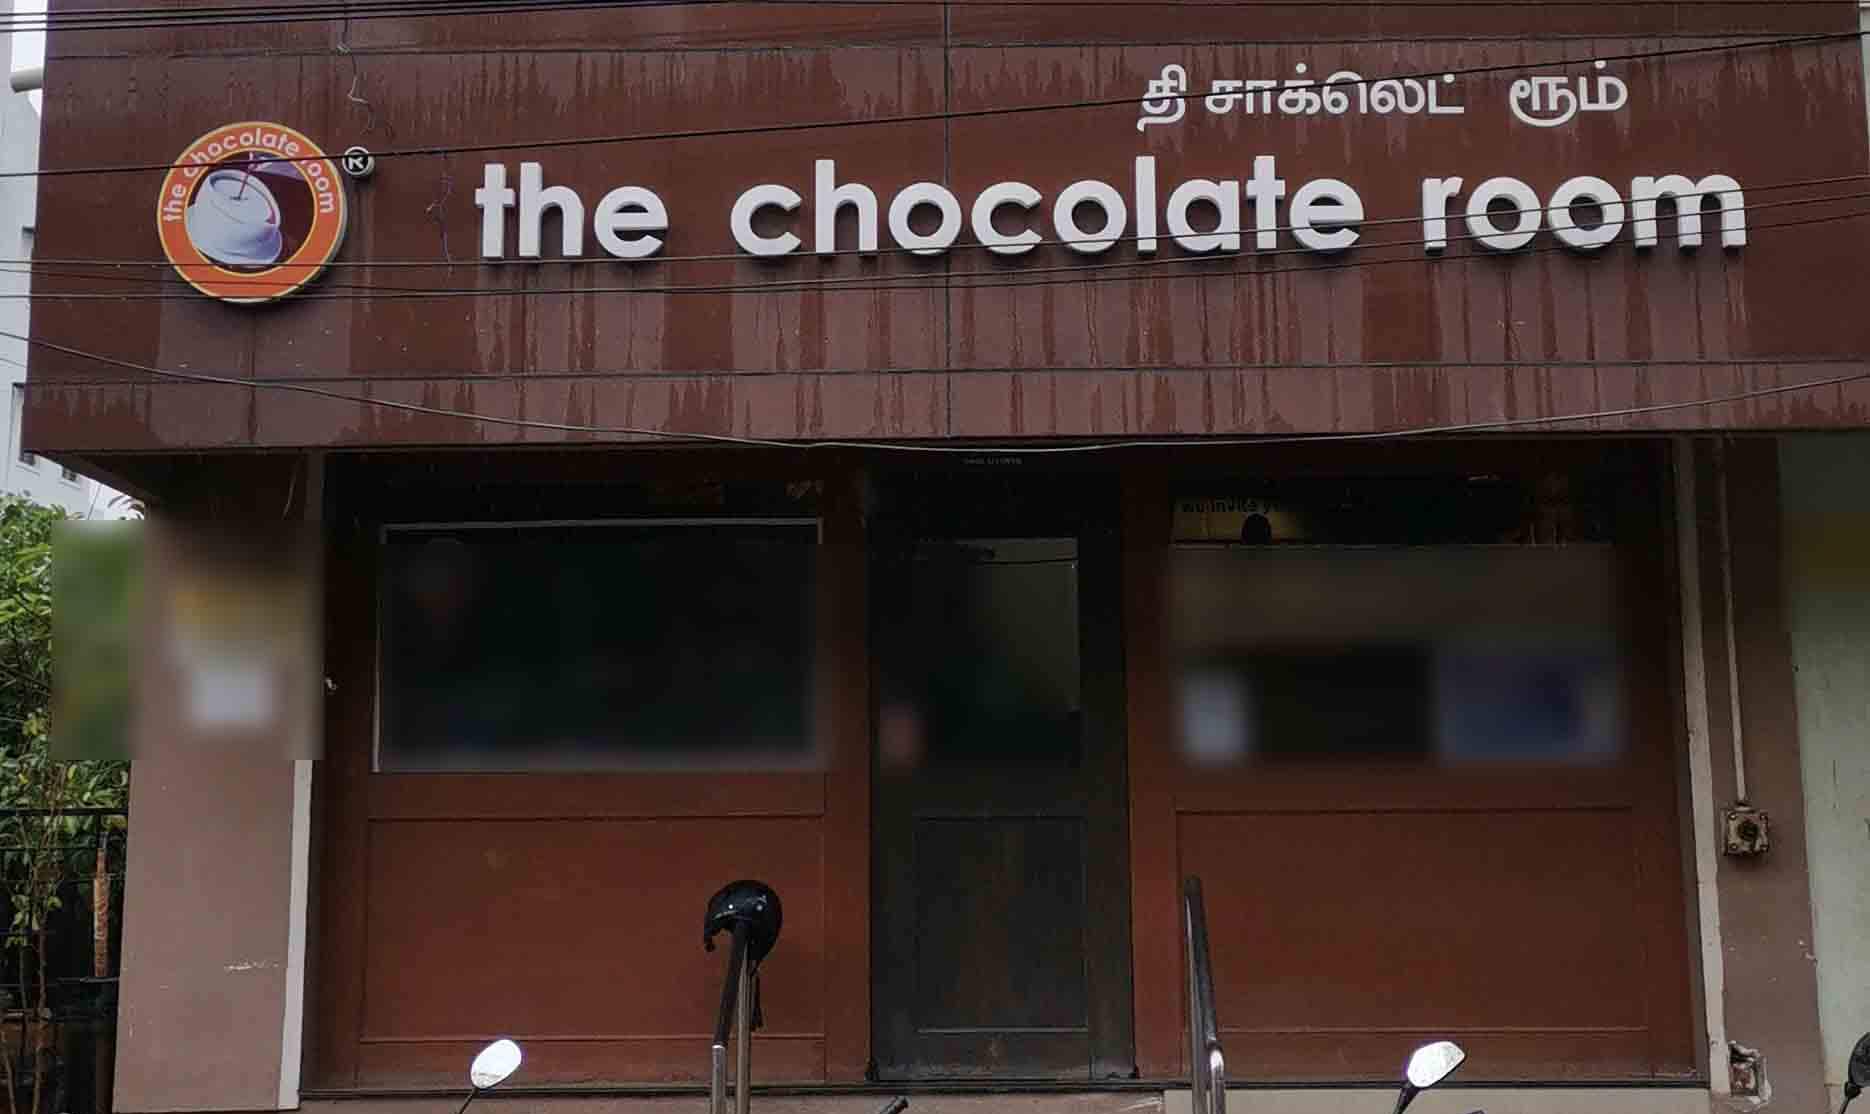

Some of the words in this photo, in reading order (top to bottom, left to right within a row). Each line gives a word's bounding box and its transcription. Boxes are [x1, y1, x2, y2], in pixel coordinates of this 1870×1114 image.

[1136, 63, 1187, 131] தி
[1510, 60, 1628, 127] ரூம்
[164, 184, 187, 222] the
[183, 128, 300, 178] chocolate
[475, 161, 669, 258] the
[730, 155, 1361, 256] chocolate
[1422, 174, 1746, 250] room
